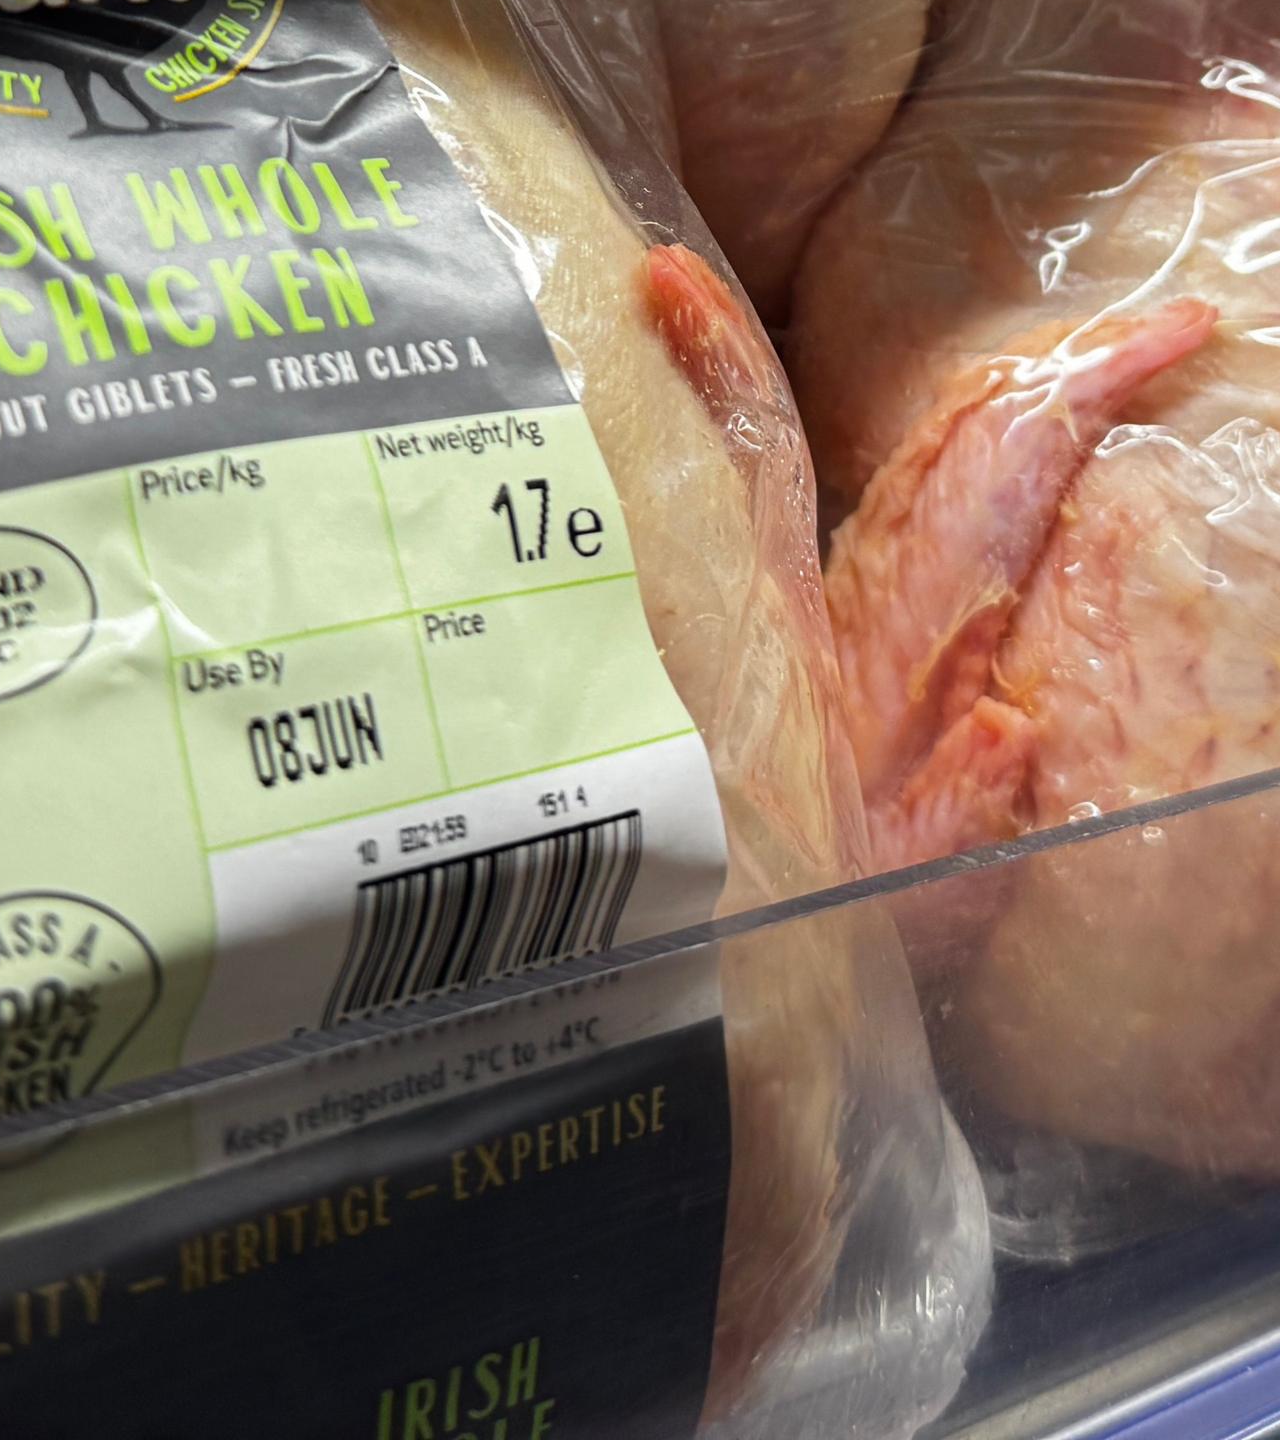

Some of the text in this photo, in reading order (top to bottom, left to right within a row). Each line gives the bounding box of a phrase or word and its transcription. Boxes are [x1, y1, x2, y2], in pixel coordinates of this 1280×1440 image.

[144, 13, 251, 92] CHICKEN
[126, 157, 420, 251] WHOLE
[67, 369, 218, 423] GIBLETS
[267, 347, 359, 394] FRESH
[364, 338, 459, 382] CLASS
[466, 338, 489, 368] A
[376, 416, 546, 462] Net weight/kg
[139, 457, 267, 503] Price/kg
[567, 503, 605, 559] e
[423, 608, 486, 643] Price
[184, 650, 286, 695] Use By
[245, 692, 385, 790] 08JUN
[69, 923, 98, 966] A
[223, 1113, 290, 1156] Keep
[295, 1067, 447, 1130] refrigerated
[512, 1040, 535, 1065] to
[180, 1184, 393, 1293] HERITAGE
[453, 1085, 667, 1204] EXPERTISE
[377, 1336, 540, 1440] IRISH
